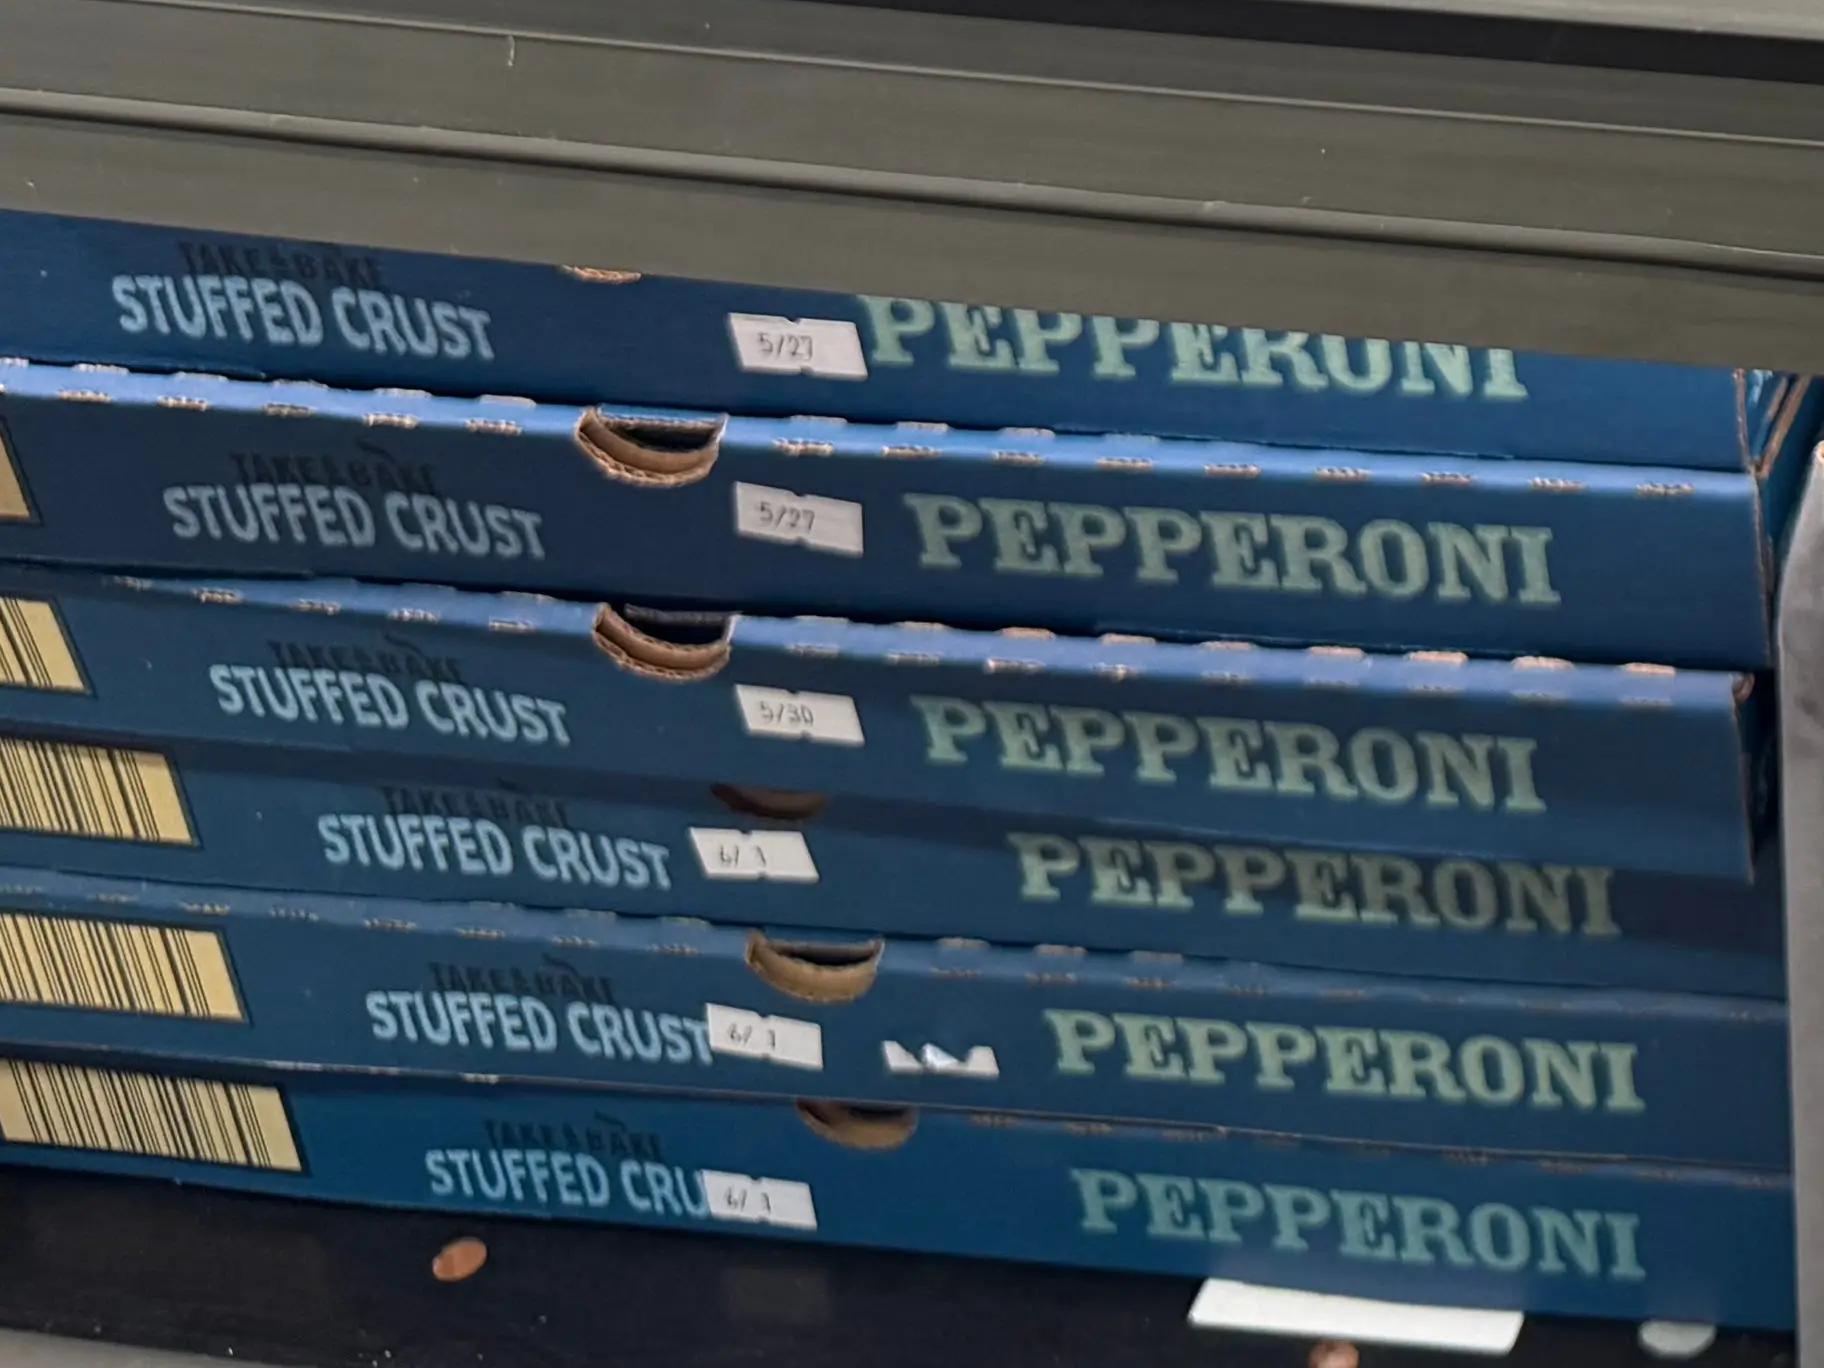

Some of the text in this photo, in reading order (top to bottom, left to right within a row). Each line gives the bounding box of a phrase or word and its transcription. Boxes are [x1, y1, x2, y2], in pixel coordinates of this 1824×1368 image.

[112, 274, 496, 361] STUFFED CRUST
[856, 292, 1529, 400] PEPPERONI
[163, 484, 547, 560] STUFFED CRUST
[903, 492, 1562, 607] PEPPERONI
[209, 664, 571, 748] STUFFED CRUST
[909, 694, 1548, 814] PEPPERONI
[366, 990, 715, 1065] STUFFED CRUST
[1043, 1008, 1648, 1113] PEPPERONI
[1070, 1167, 1648, 1280] PEPPERONI
